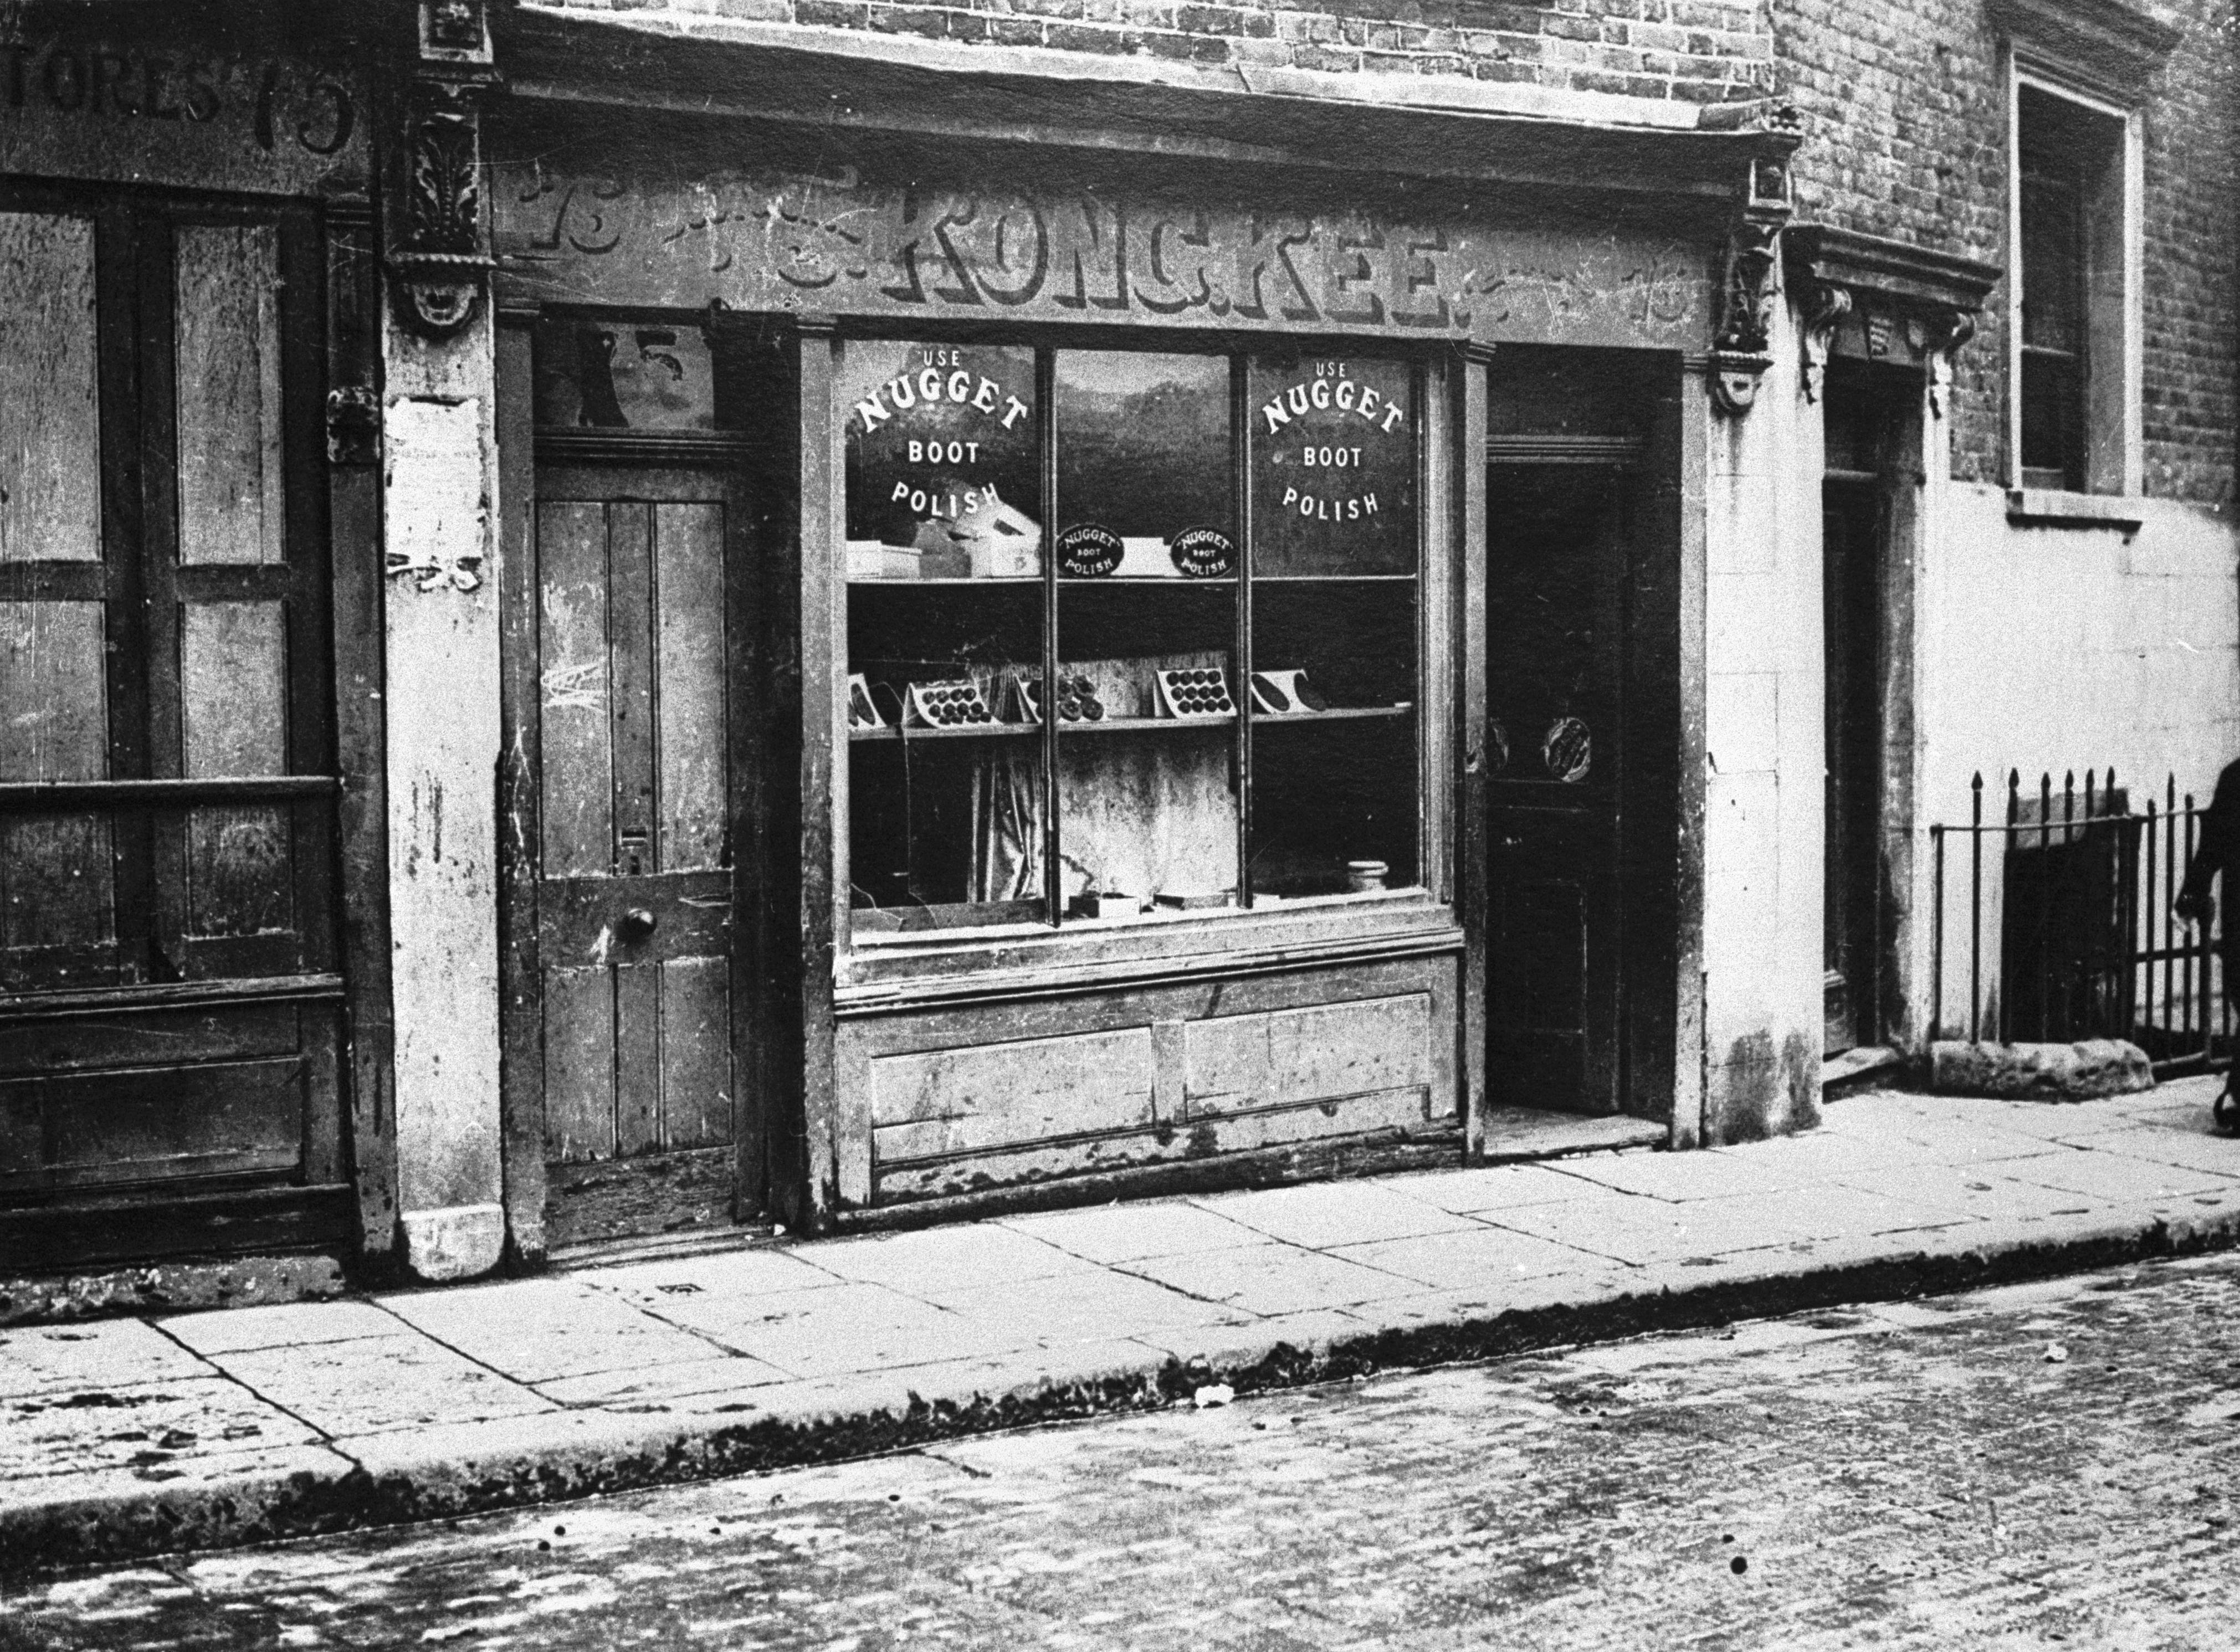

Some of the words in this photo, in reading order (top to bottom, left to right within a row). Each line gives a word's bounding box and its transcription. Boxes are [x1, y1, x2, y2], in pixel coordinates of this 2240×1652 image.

[924, 350, 960, 366] USE
[1316, 362, 1346, 378] USE
[855, 368, 1027, 433] NUGGET
[1262, 379, 1403, 434] NUGGET
[909, 440, 979, 463] BOOT
[1304, 447, 1361, 466] BOOT
[891, 481, 999, 517] POLISH
[1282, 487, 1378, 521] POLISH
[1077, 548, 1101, 556] BOOT
[1065, 557, 1114, 575] POLISH
[1181, 557, 1227, 575] POLISH
